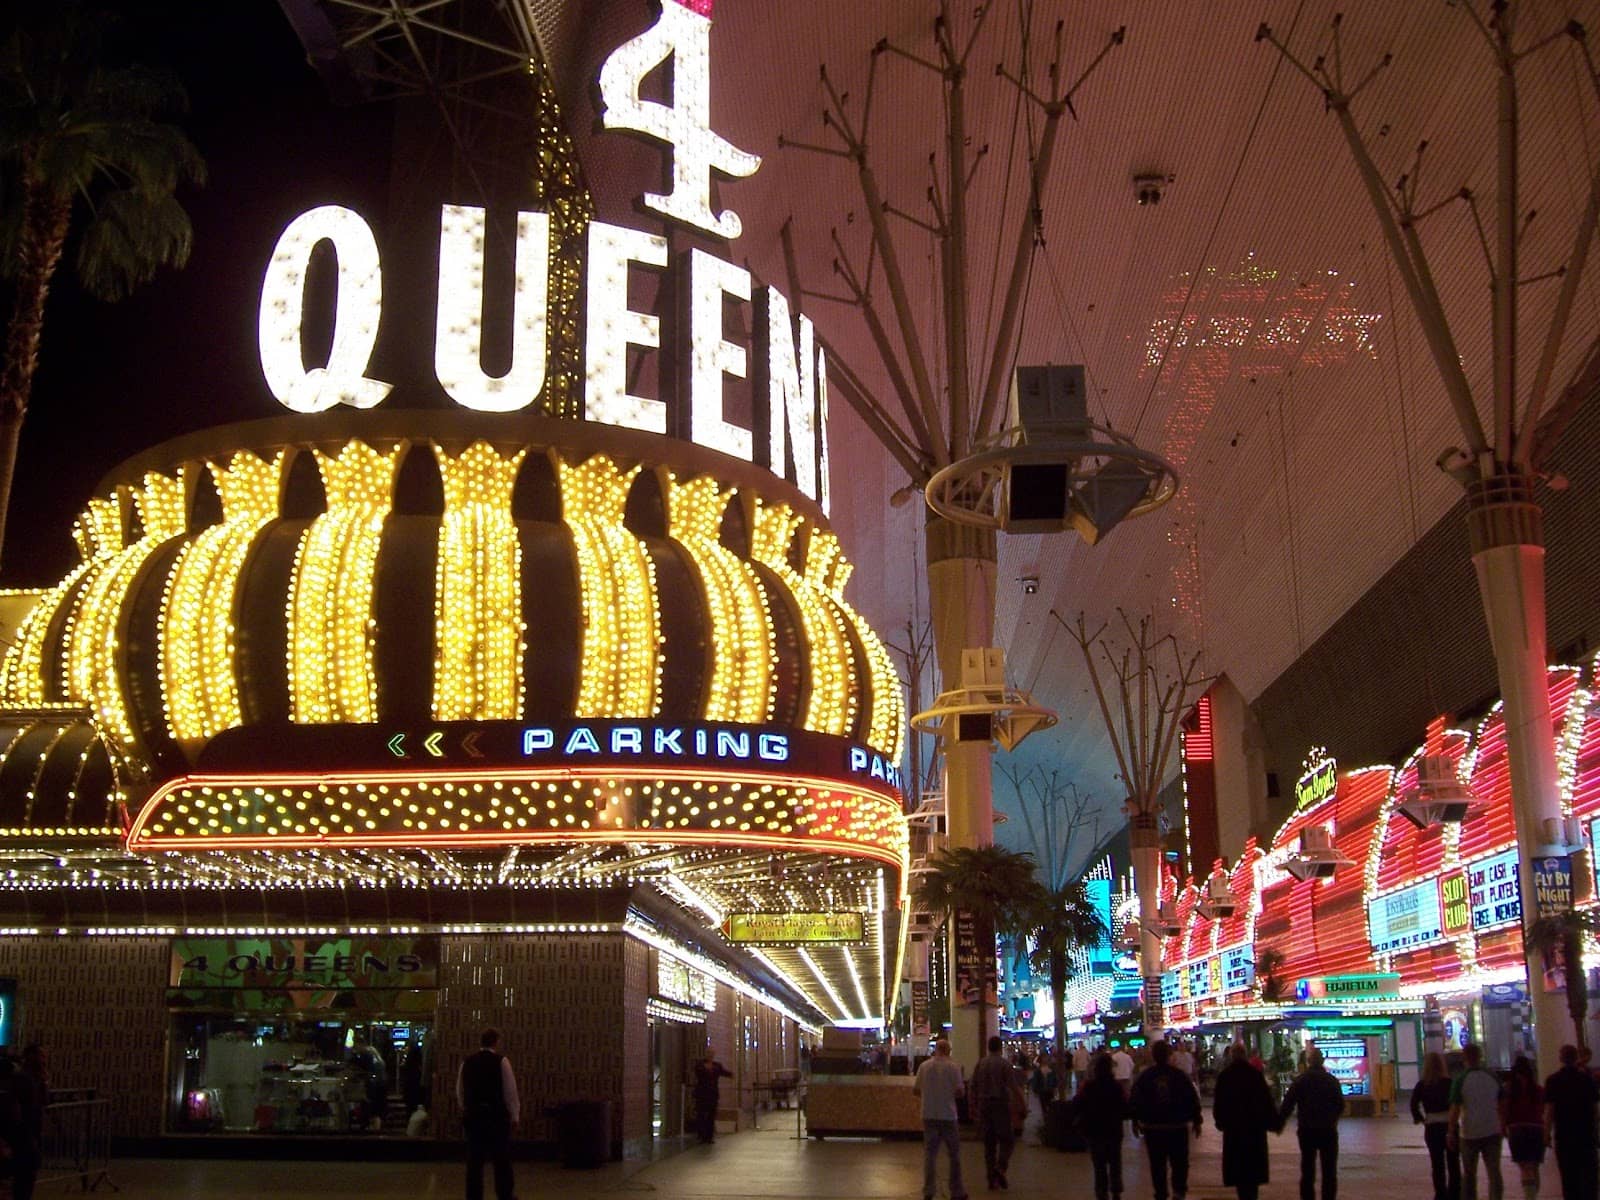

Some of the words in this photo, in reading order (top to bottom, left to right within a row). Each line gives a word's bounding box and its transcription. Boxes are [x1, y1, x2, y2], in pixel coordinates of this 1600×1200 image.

[599, 0, 762, 239] 4
[523, 727, 789, 761] PARKING
[1489, 862, 1507, 883] CASH
[1535, 871, 1552, 886] FLY
[1555, 871, 1571, 886] BY
[1442, 876, 1464, 903] SLOT
[1537, 887, 1572, 902] NIGHT
[1445, 903, 1467, 930] CLUB
[1474, 908, 1489, 927] FREE
[184, 956, 208, 972] 4
[228, 955, 422, 973] QUEENS
[1325, 980, 1378, 992] FUJIFILM
